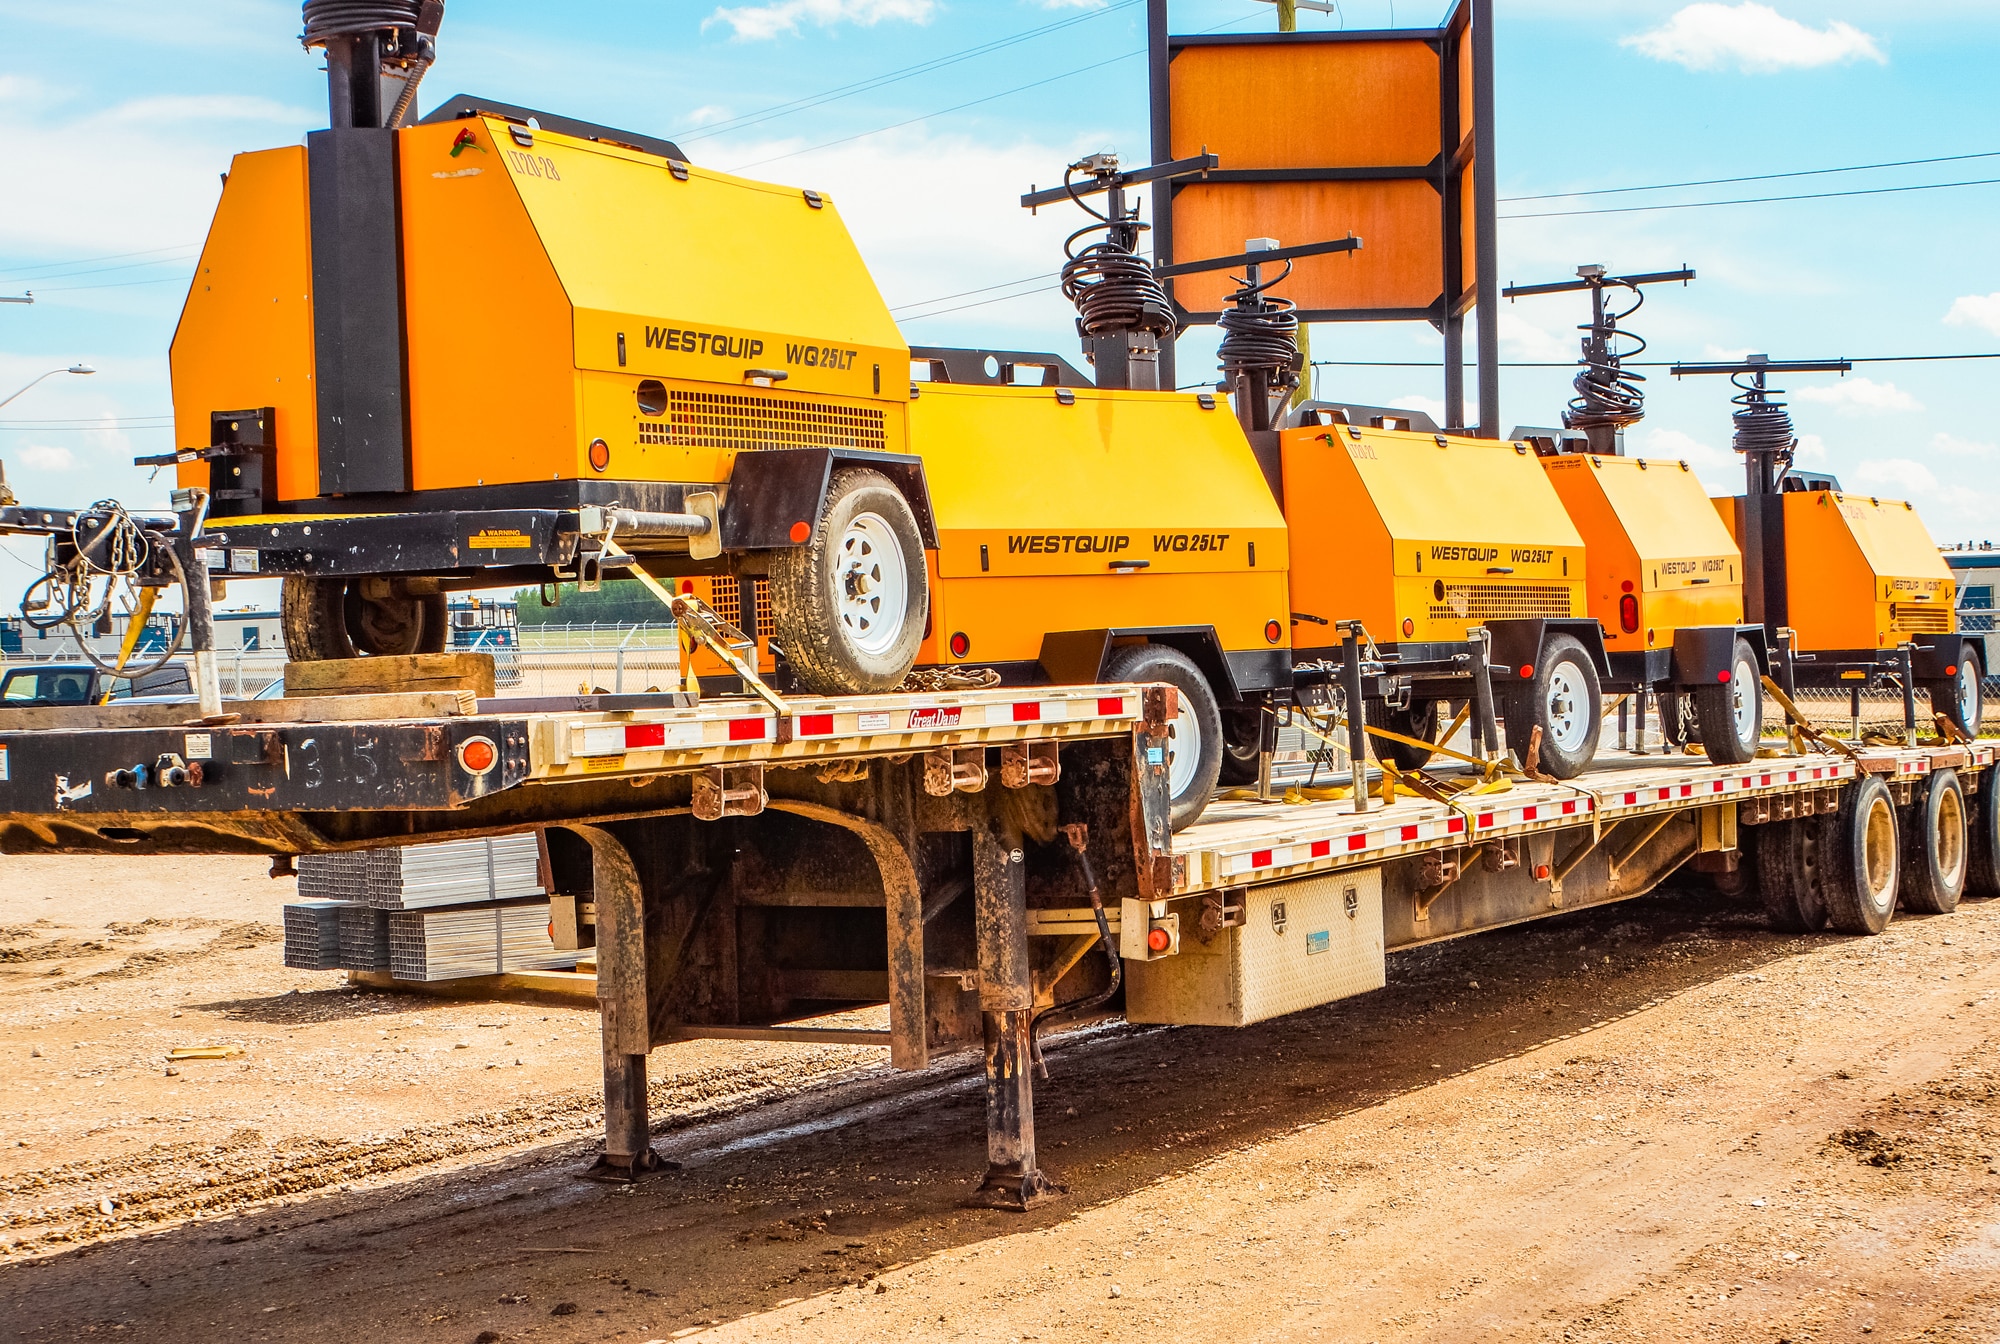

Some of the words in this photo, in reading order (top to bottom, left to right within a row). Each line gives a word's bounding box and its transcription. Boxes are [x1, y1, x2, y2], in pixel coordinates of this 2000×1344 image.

[506, 149, 561, 182] LT20-28
[645, 325, 764, 360] WESTQUIP
[785, 343, 857, 371] WQ25LT
[487, 529, 521, 537] WARNING
[1008, 535, 1130, 554] WESTQUIP
[1152, 534, 1230, 552] WQ25LT
[1431, 545, 1499, 563] WESTQUIP
[1511, 549, 1554, 565] WQ25LT
[1661, 561, 1697, 576] WESTQUIP
[1891, 579, 1919, 591] WESTQUIP
[909, 709, 936, 728] Great
[936, 708, 959, 726] Dane
